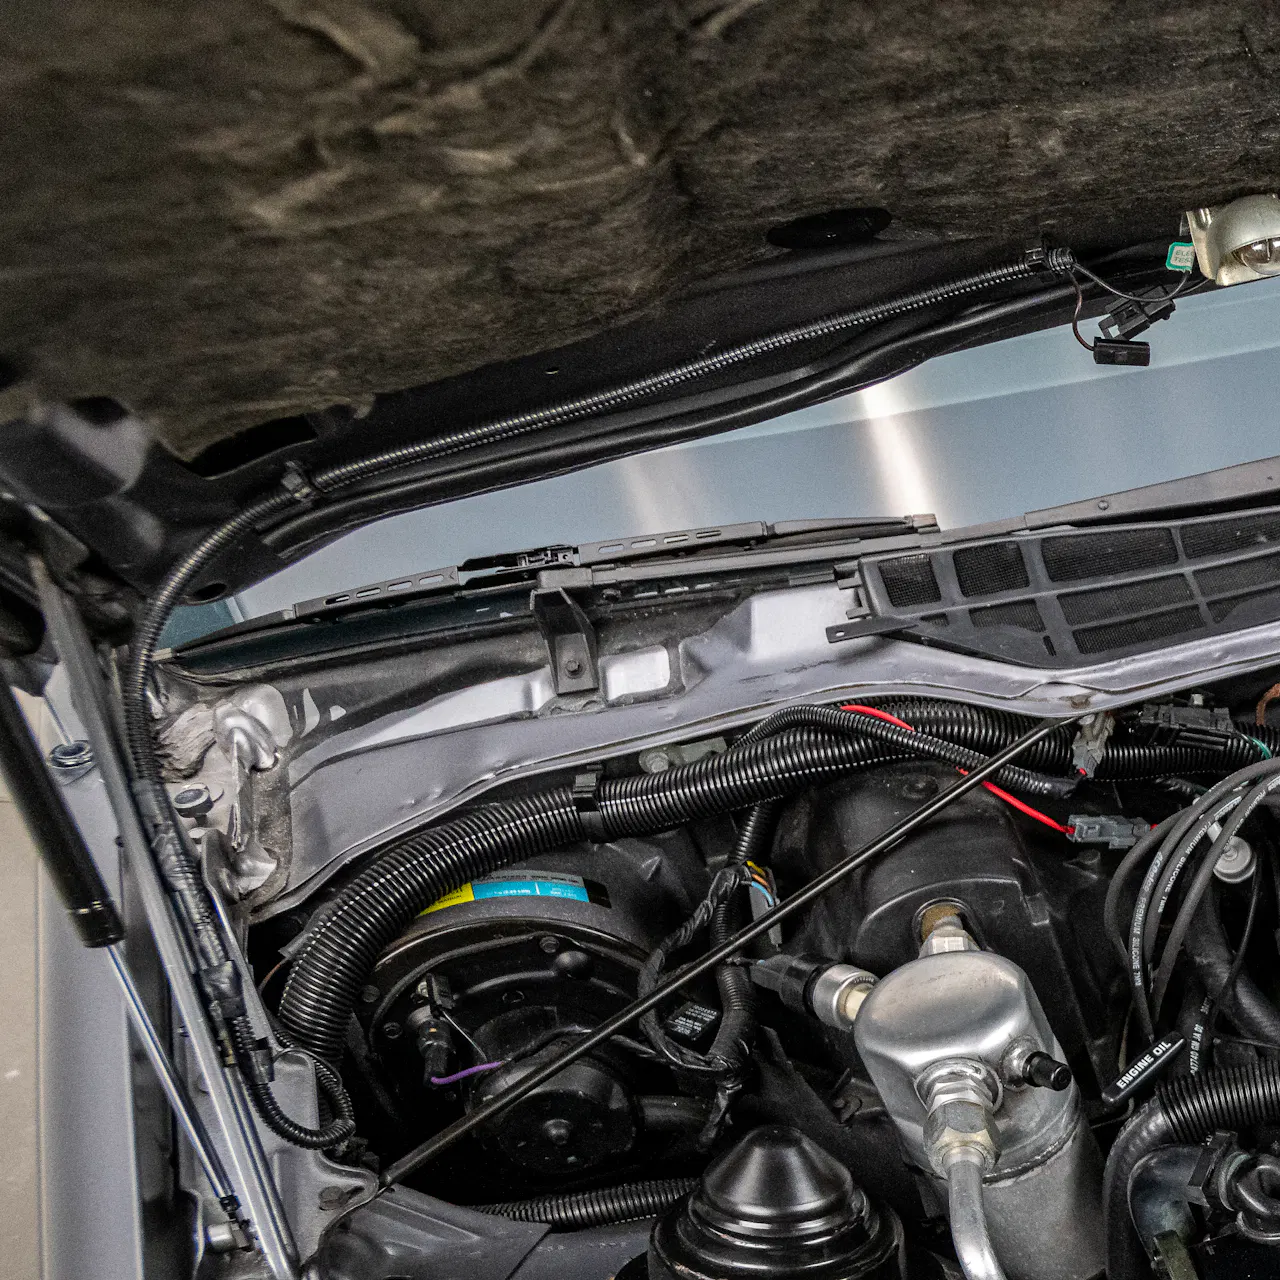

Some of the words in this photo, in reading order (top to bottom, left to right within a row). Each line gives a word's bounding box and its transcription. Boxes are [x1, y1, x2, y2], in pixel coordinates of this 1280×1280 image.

[1164, 856, 1187, 893] SILICONE
[1133, 897, 1147, 935] PREMIUM
[1132, 936, 1142, 969] SILICONE
[1116, 1053, 1155, 1090] ENGINE
[1152, 1040, 1172, 1057] OIL
